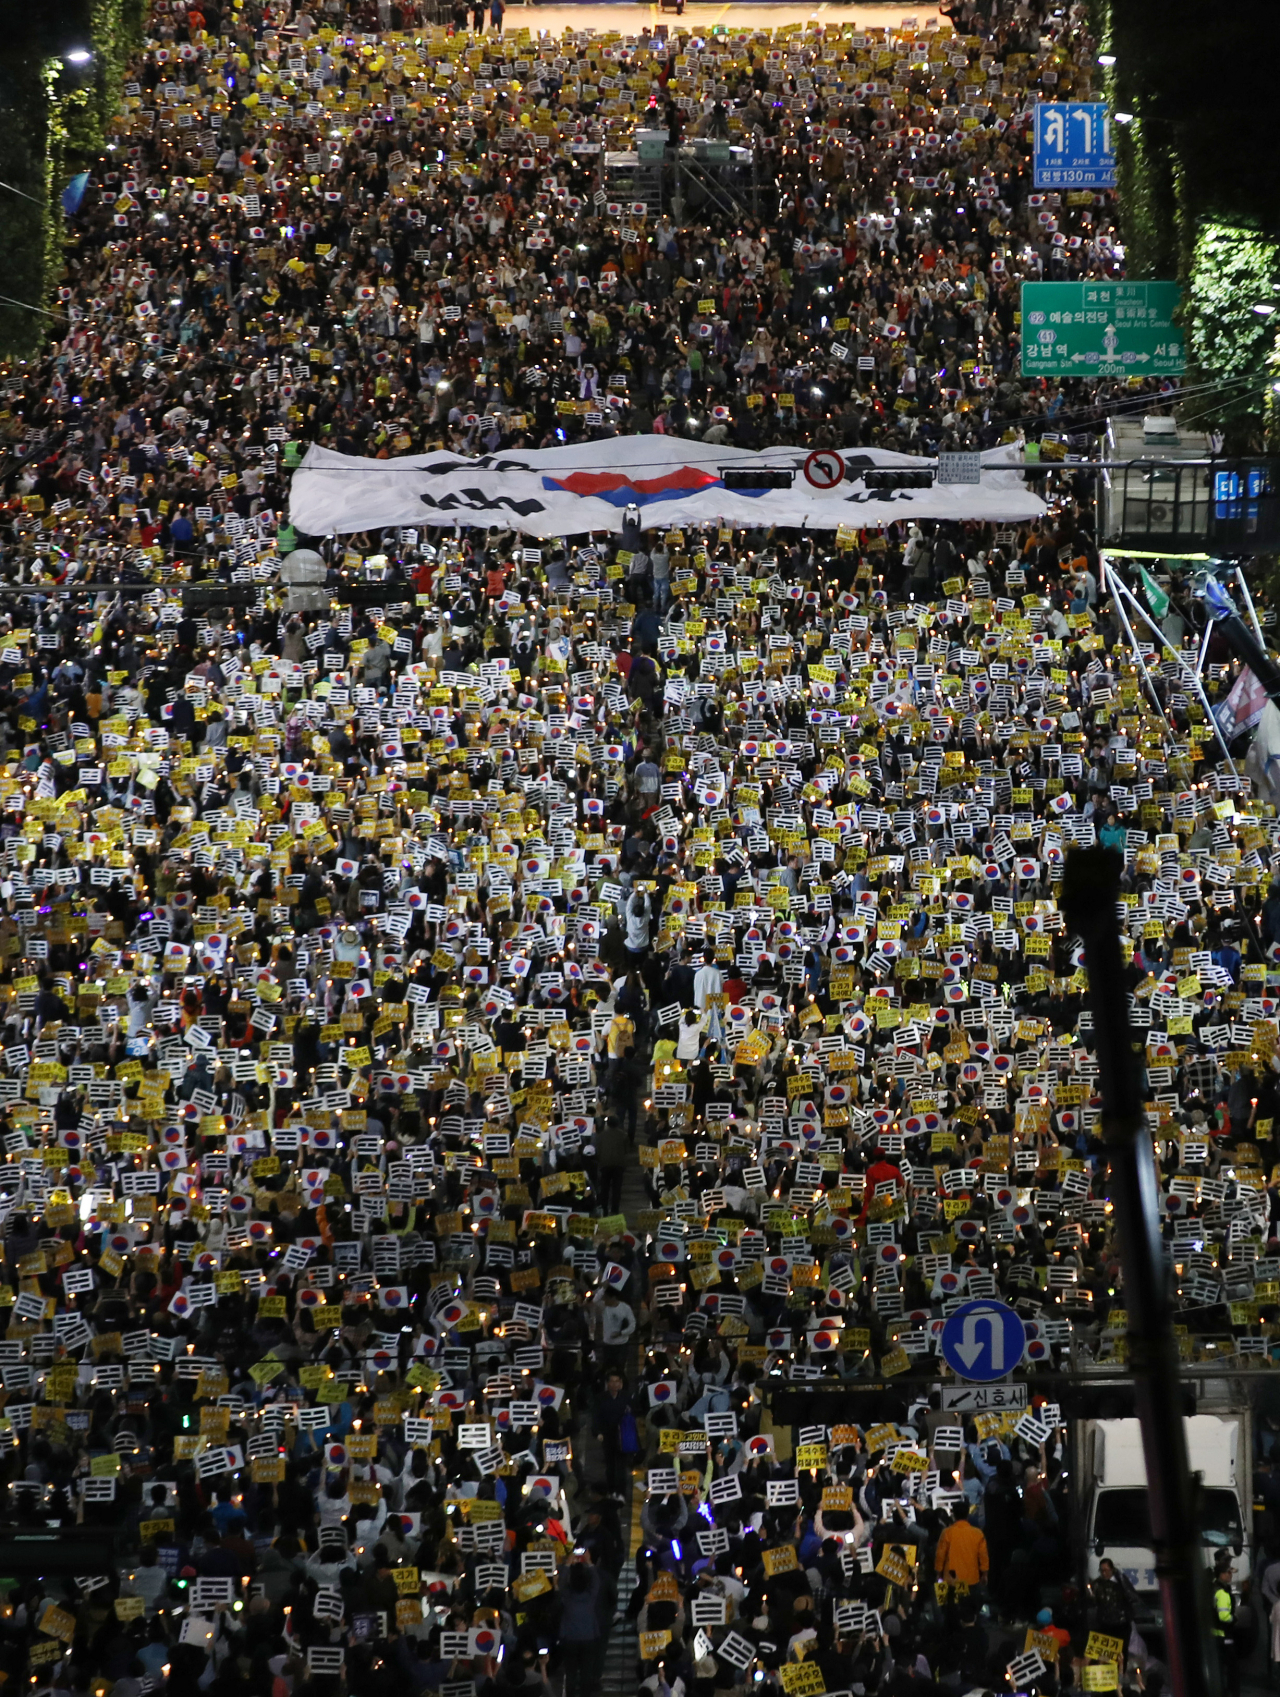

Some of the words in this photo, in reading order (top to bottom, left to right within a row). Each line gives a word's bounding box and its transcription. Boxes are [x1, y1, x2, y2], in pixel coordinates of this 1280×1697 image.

[1087, 290, 1110, 302] 과천
[1049, 311, 1108, 324] 예술의전당
[1114, 320, 1132, 328] Seoul
[1133, 320, 1147, 328] Arts
[1149, 320, 1170, 328] Center
[1025, 359, 1058, 370] Gangnam
[1060, 359, 1072, 368] Stn
[1153, 359, 1174, 367] Seoul
[1098, 364, 1125, 374] 200m
[973, 1387, 1023, 1408] 신호시
